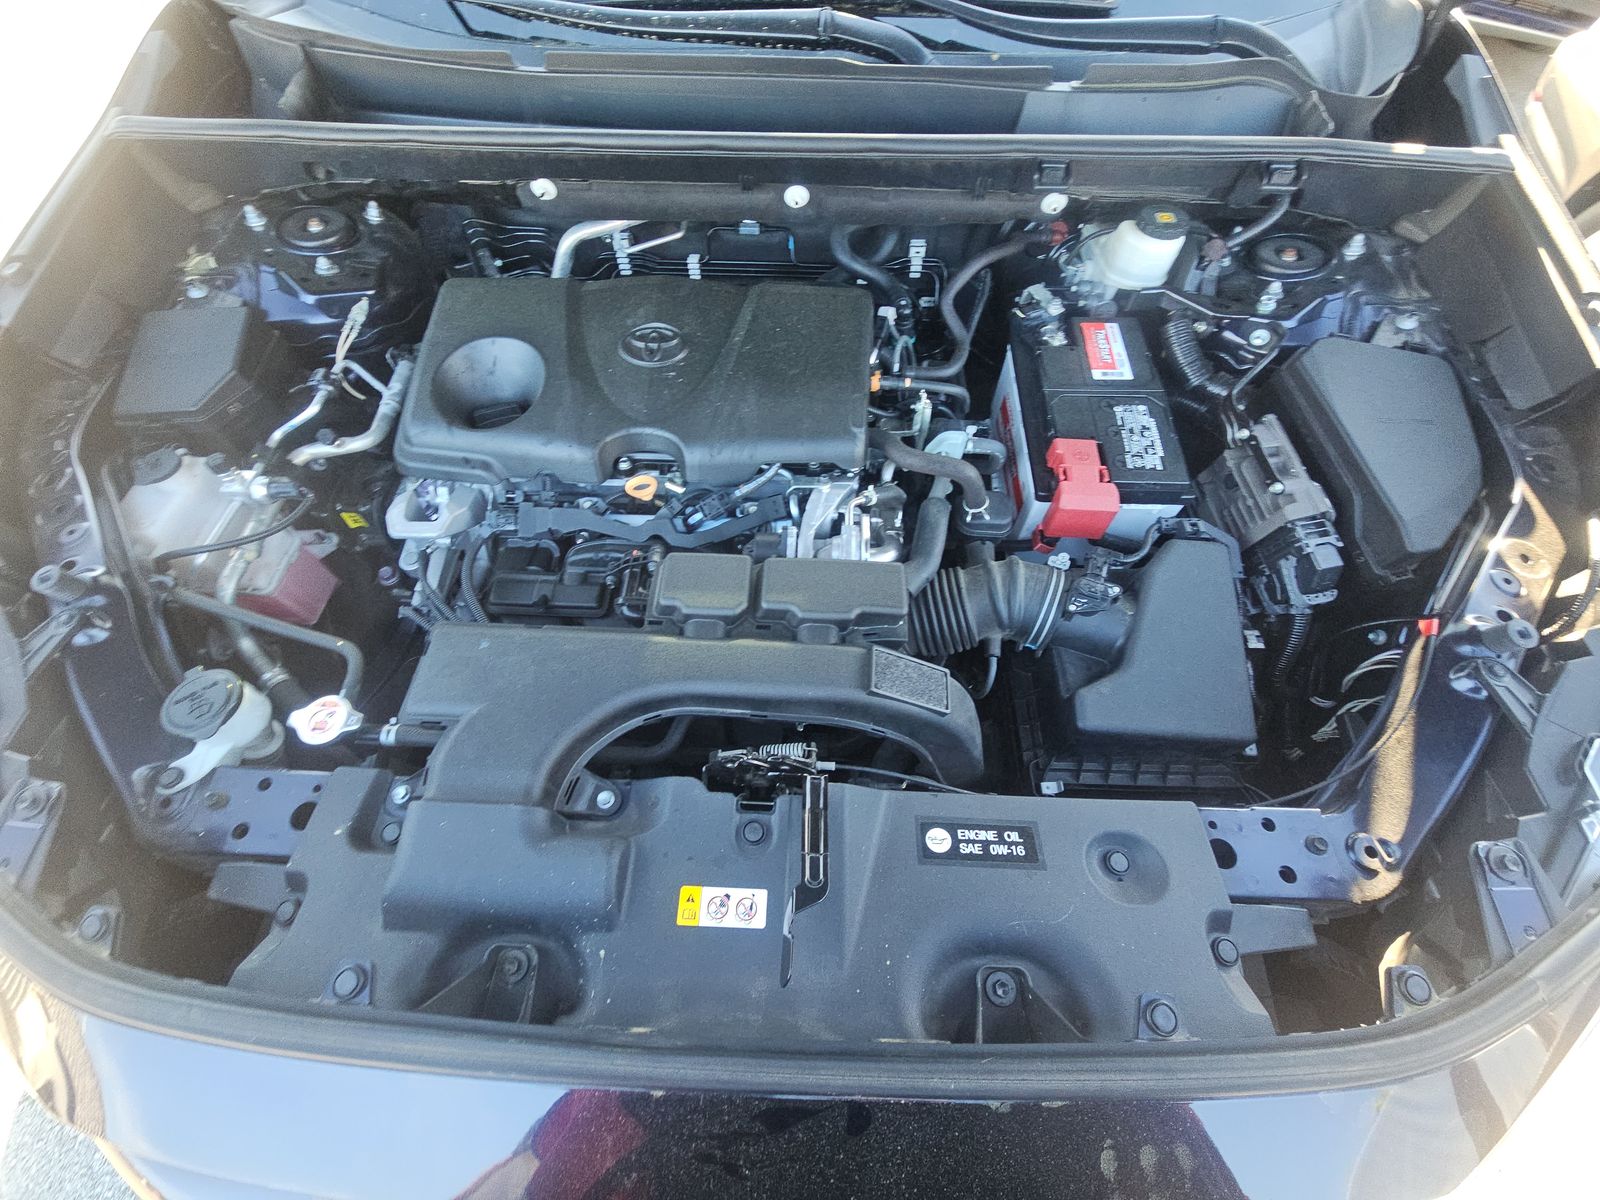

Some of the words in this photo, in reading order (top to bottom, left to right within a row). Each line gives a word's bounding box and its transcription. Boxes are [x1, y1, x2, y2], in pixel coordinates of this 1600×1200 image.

[957, 829, 998, 841] ENGINE
[1004, 831, 1024, 842] OIL
[959, 843, 983, 854] SAE
[990, 844, 1026, 856] 0W-16
